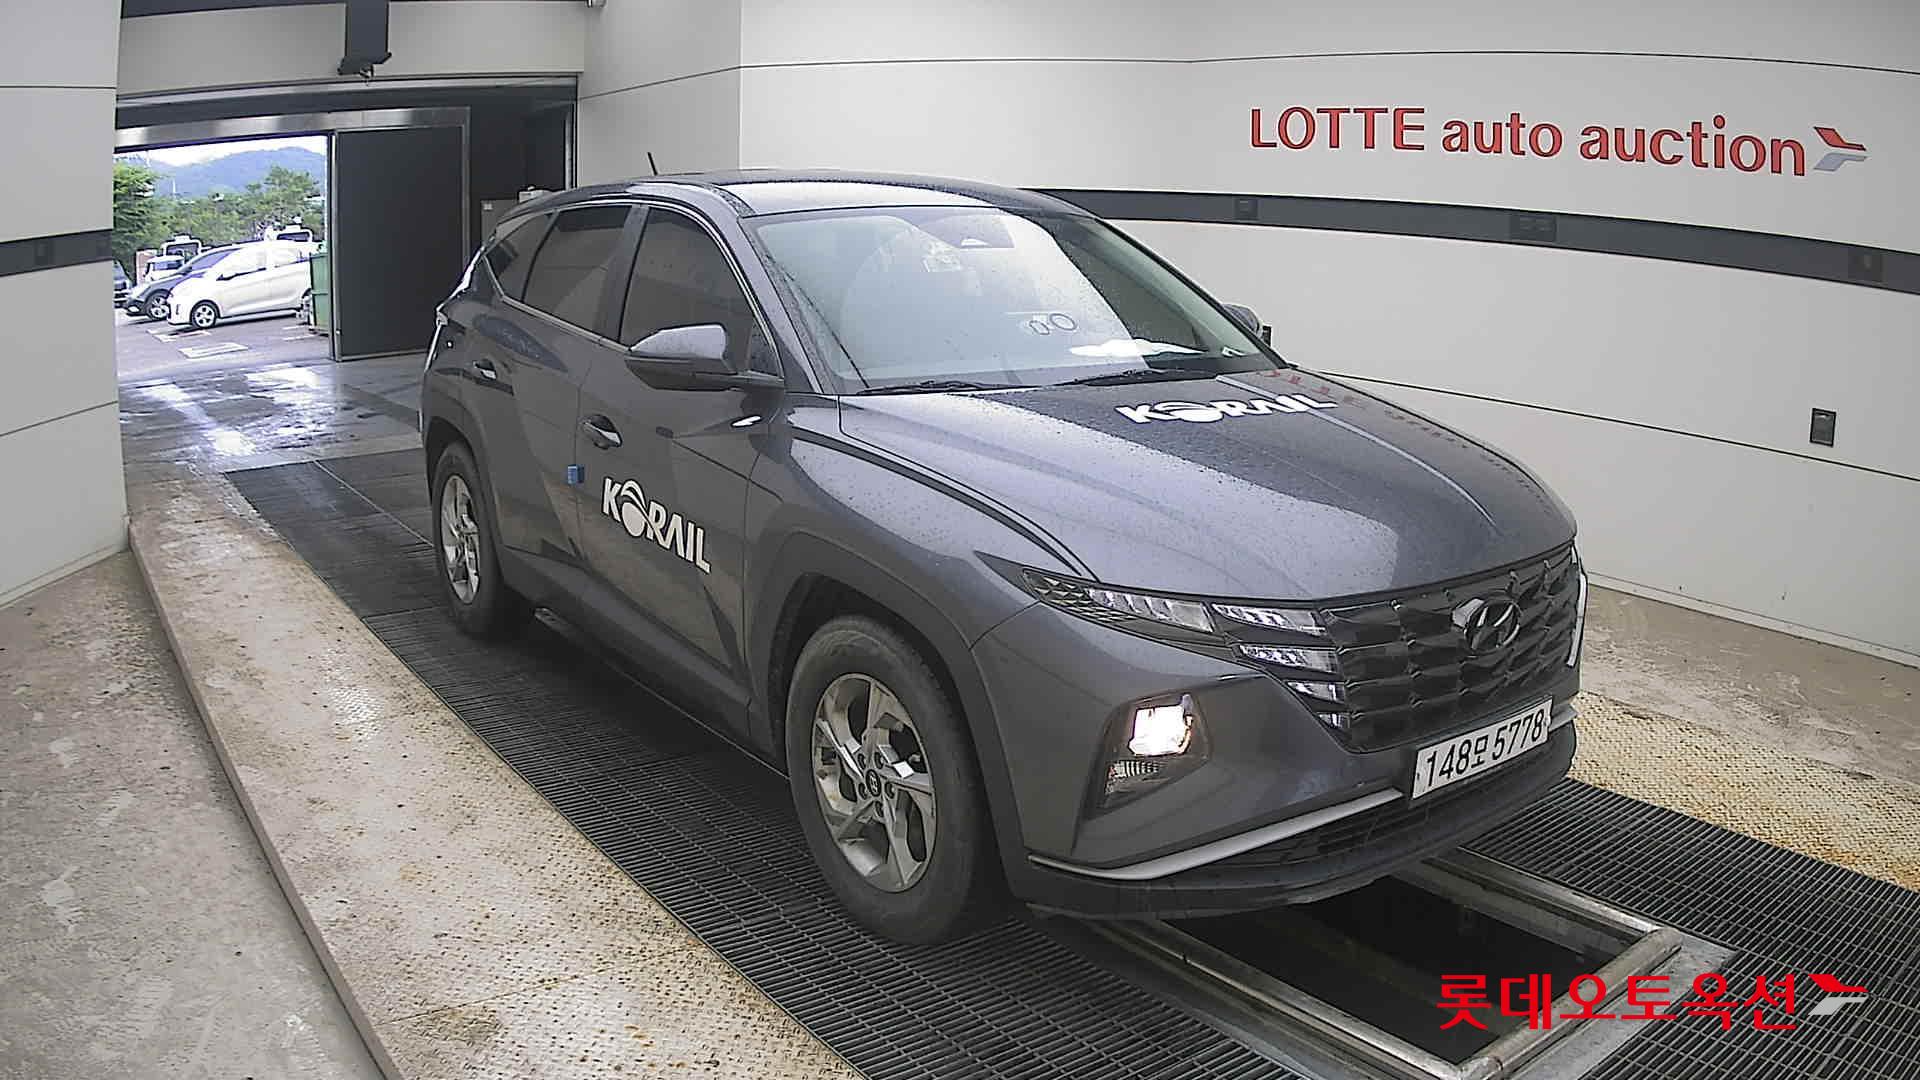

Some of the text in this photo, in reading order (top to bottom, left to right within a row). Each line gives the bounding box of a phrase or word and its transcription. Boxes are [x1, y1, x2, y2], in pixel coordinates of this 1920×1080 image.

[1250, 106, 1806, 177] LOTTE auto auction
[1115, 393, 1339, 423] KORAIL
[602, 476, 711, 574] KORAIL
[1426, 708, 1545, 787] 148모 5778
